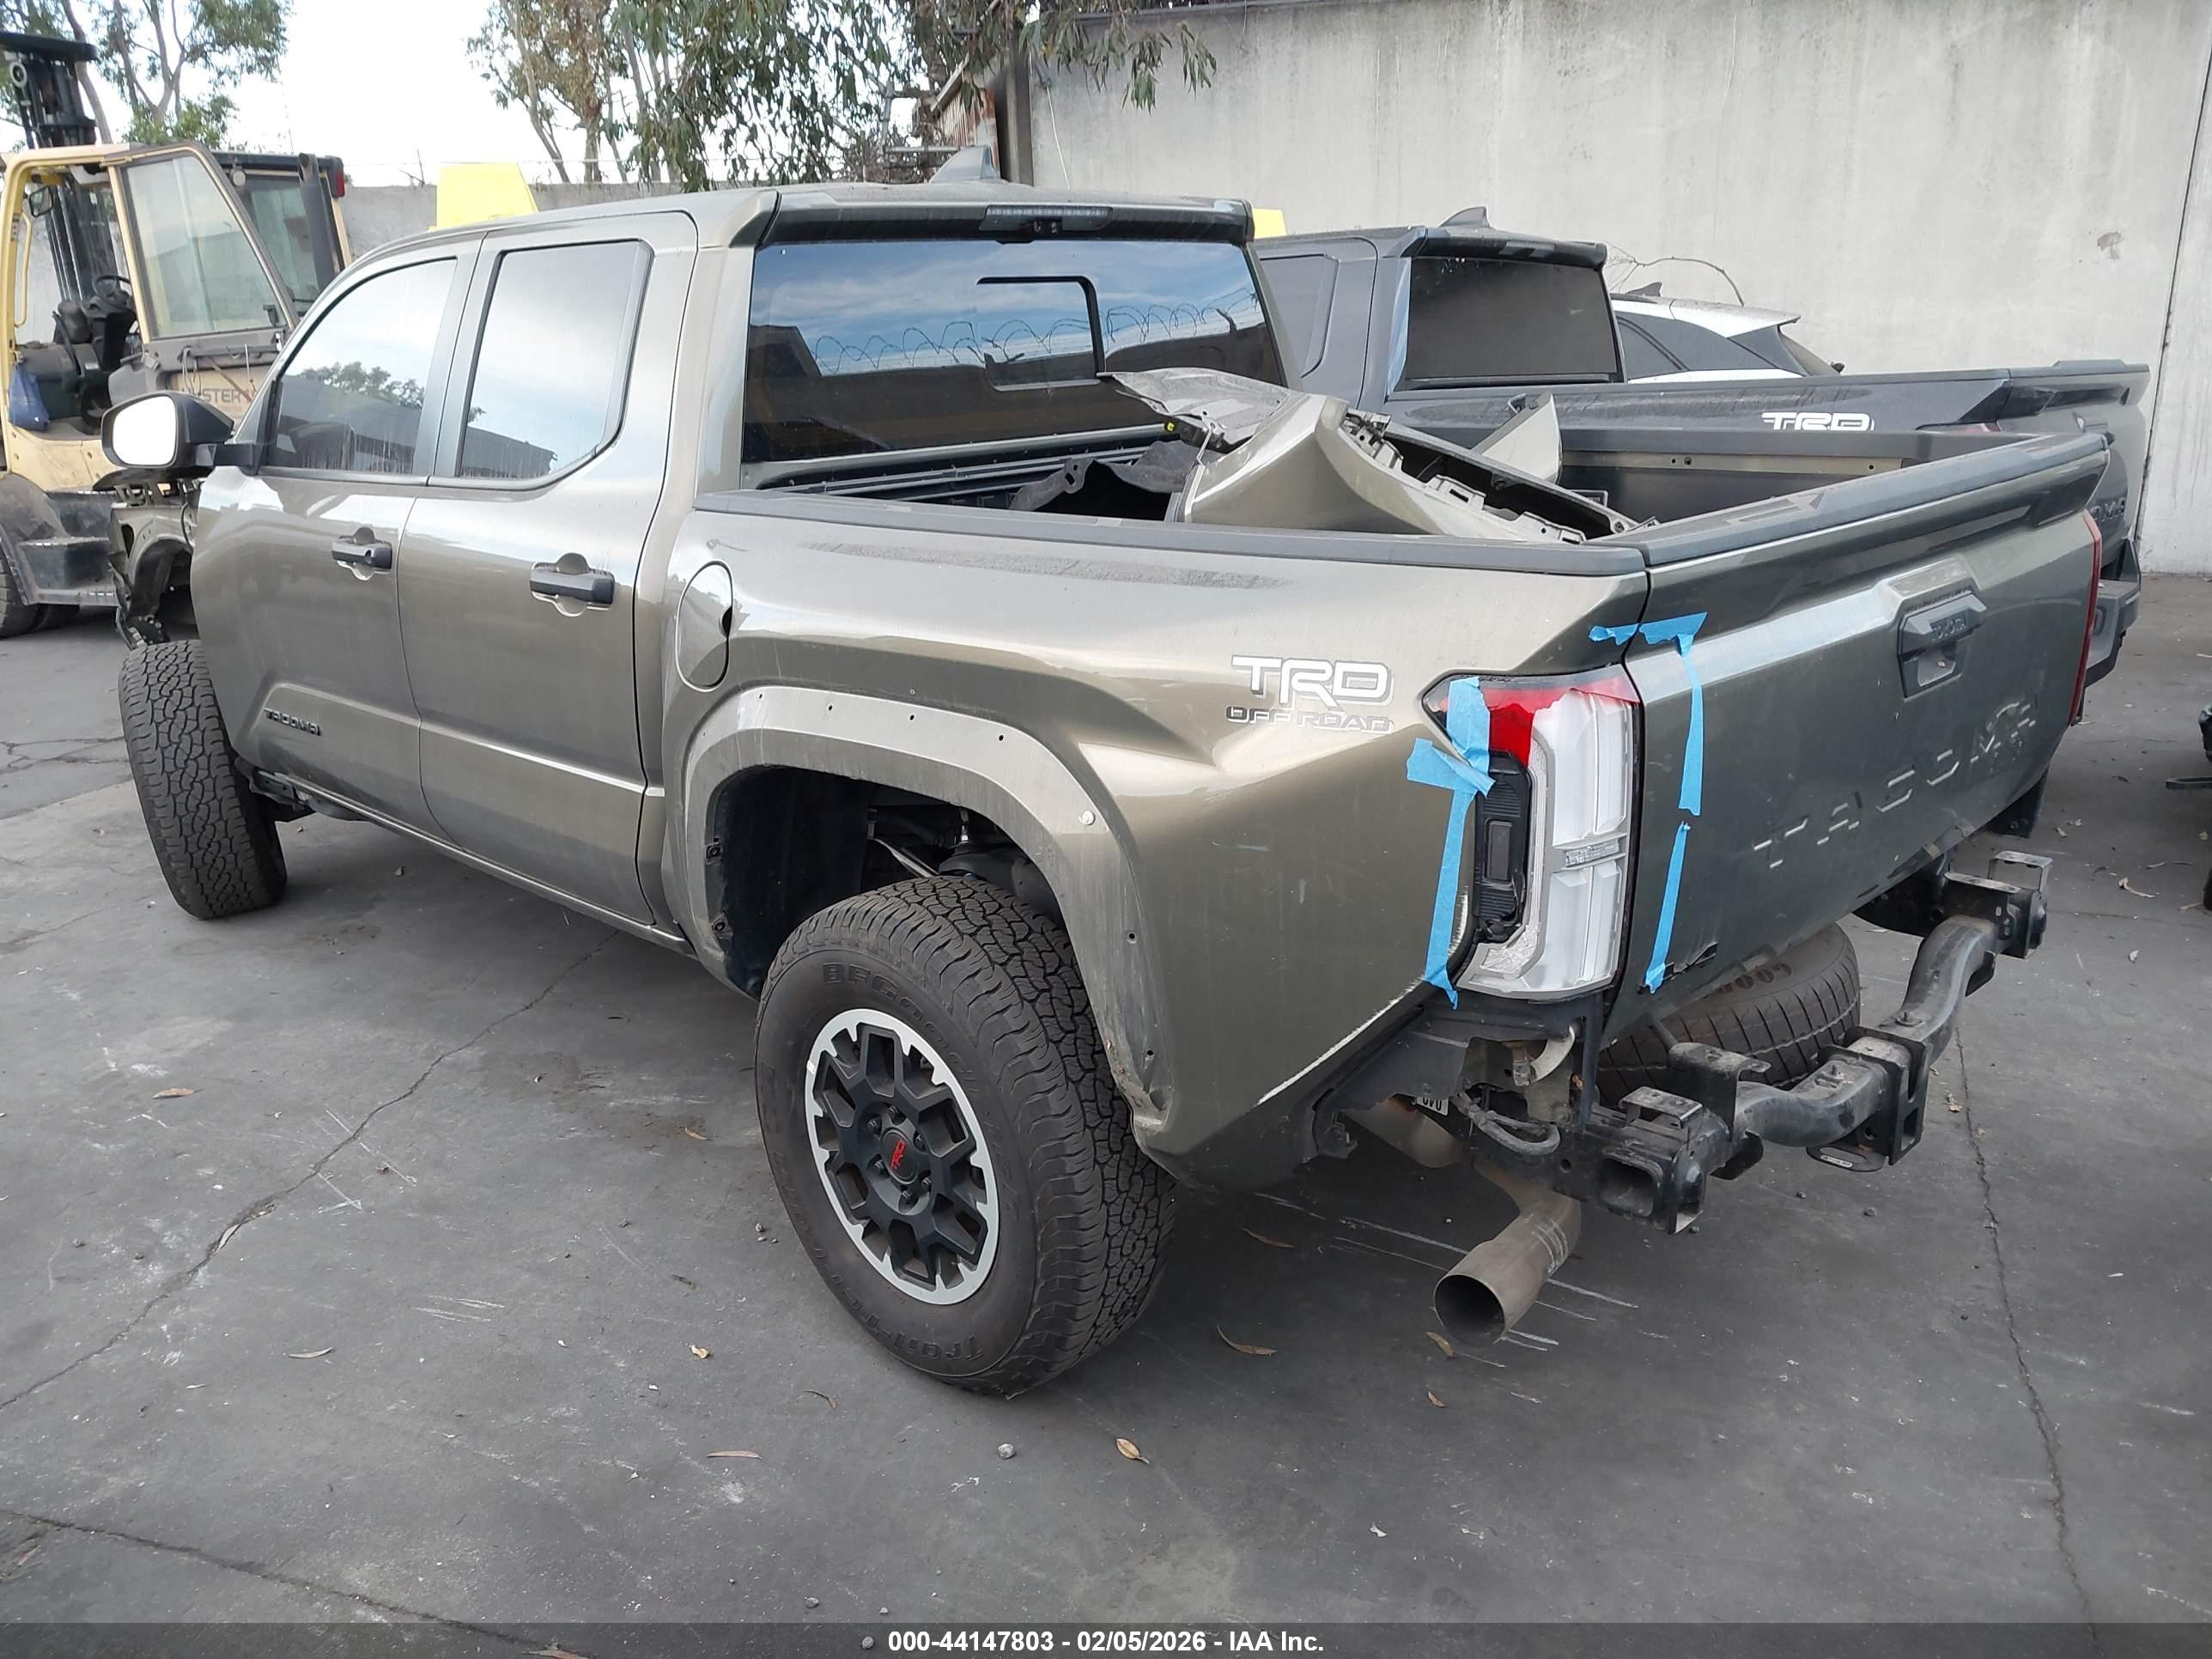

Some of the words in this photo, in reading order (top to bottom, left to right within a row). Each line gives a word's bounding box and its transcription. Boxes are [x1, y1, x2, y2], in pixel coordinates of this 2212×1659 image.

[1761, 411, 1875, 431] TRD
[1231, 654, 1395, 713] TRD
[261, 707, 324, 737] TACOMA
[1225, 706, 1292, 726] OFF
[1297, 711, 1395, 735] ROAD
[1752, 697, 2038, 870] TACOMA
